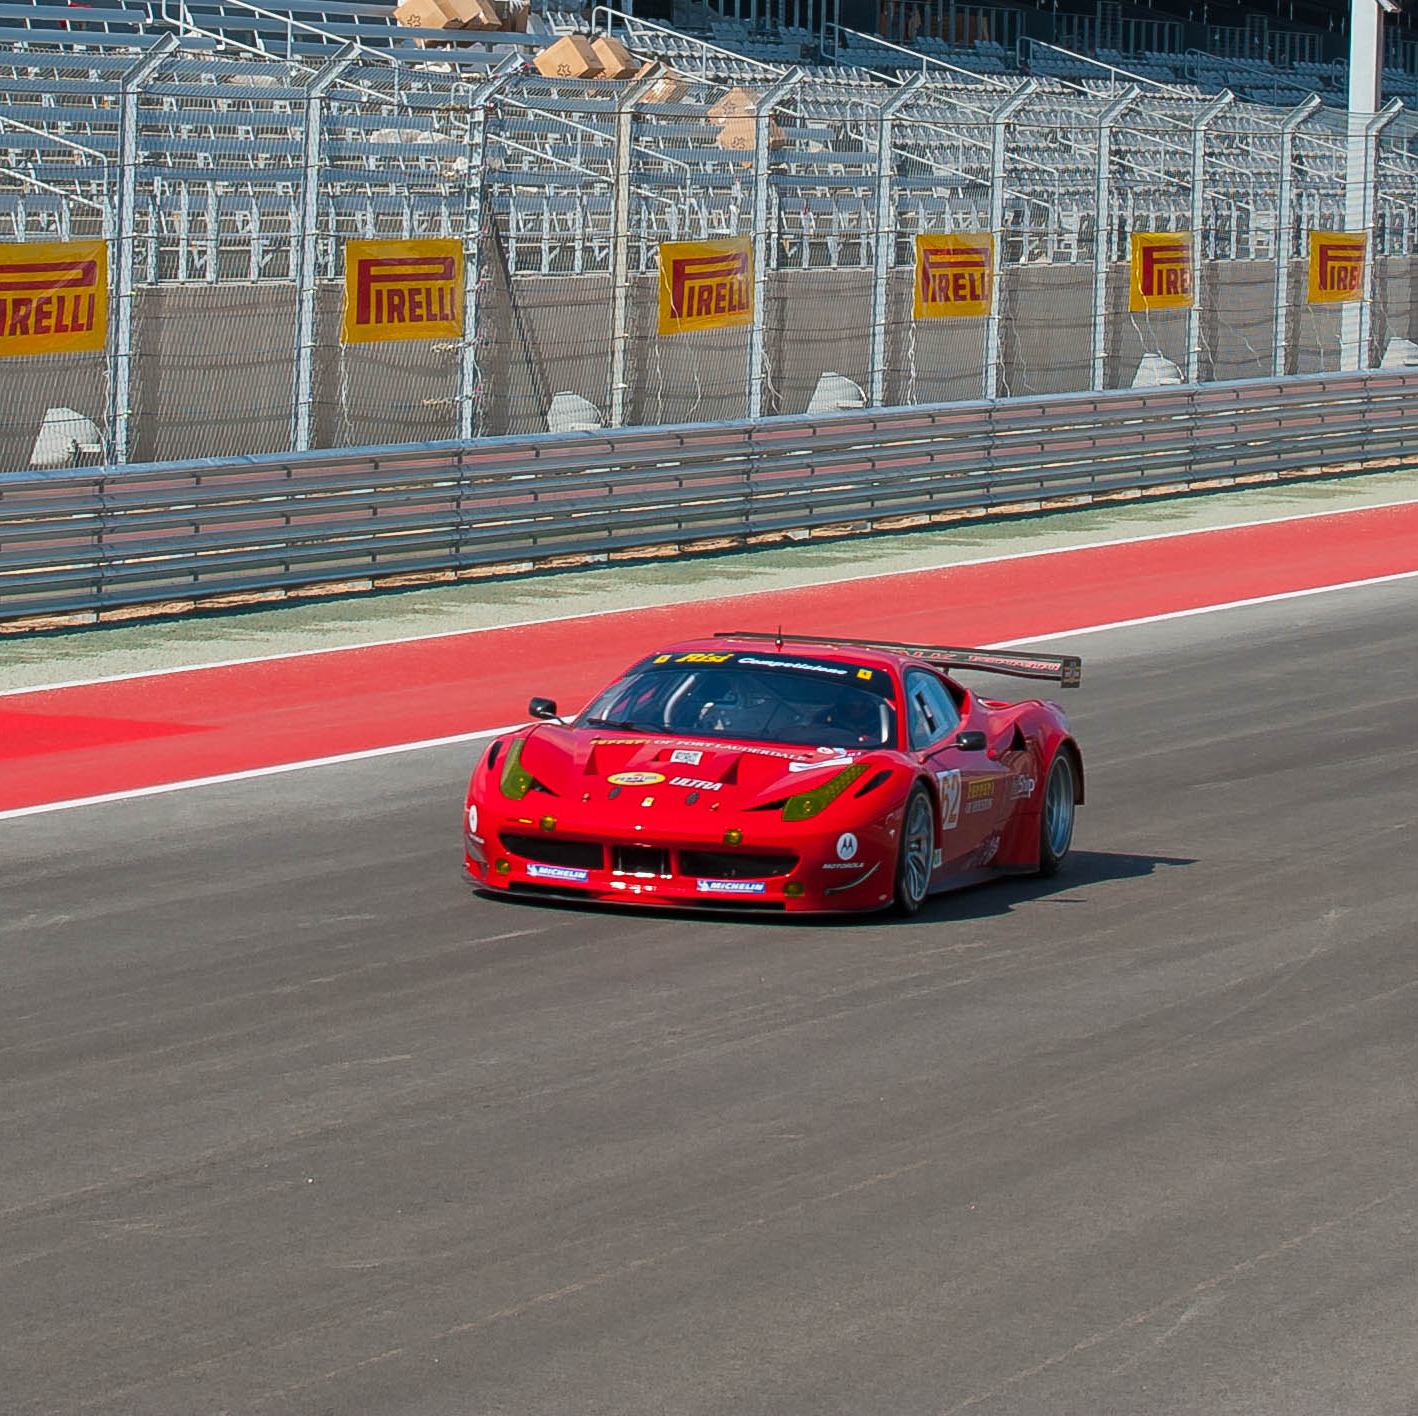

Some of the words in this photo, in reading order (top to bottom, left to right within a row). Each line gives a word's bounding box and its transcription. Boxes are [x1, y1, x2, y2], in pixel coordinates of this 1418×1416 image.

[1142, 245, 1192, 296] PIRE
[1319, 245, 1366, 290] PIRE
[356, 256, 455, 325] PIRELLI
[670, 251, 749, 319] PIRELLI
[675, 653, 735, 663] Risi
[738, 657, 848, 675] Competizione
[717, 743, 808, 761] LAUDERDALE
[669, 776, 723, 791] ULTRA
[538, 866, 587, 879] MICHELIN
[710, 881, 764, 891] MICHELIN
